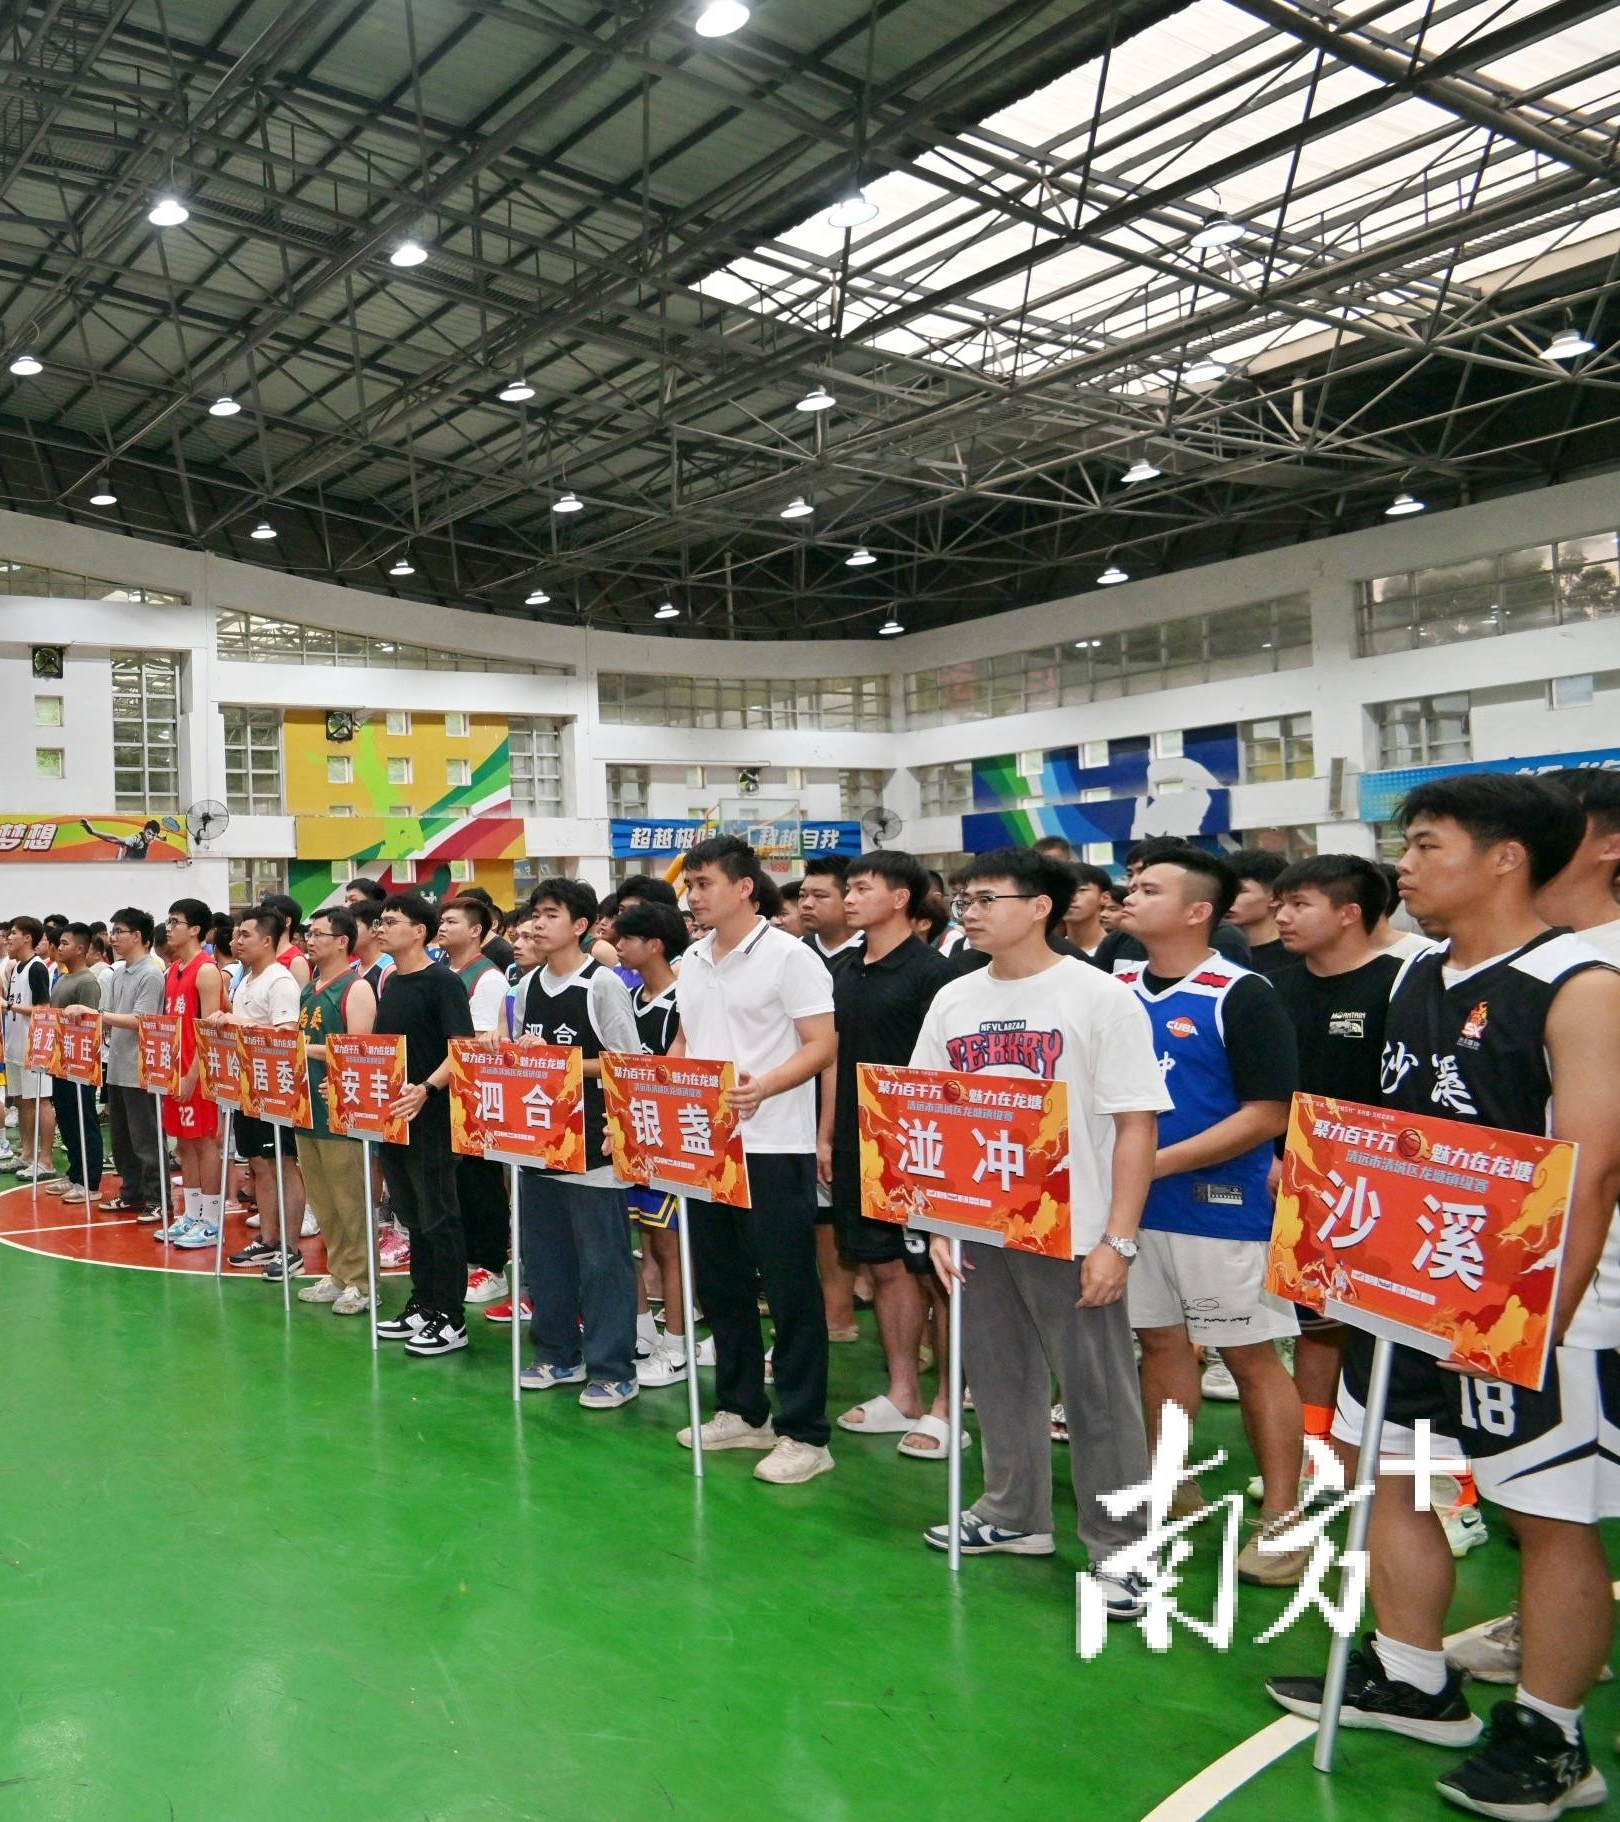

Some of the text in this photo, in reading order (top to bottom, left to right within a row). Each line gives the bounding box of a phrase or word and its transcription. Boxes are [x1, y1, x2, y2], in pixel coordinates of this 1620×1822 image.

[63, 1032, 93, 1062] 新庄
[1166, 1020, 1199, 1035] CUBA
[146, 1040, 171, 1070] 云路
[252, 1058, 295, 1095] 居委
[341, 1068, 391, 1108] 安丰
[877, 1080, 1044, 1111] 聚力百千万 魅力在龙塘
[474, 1079, 554, 1130] 泗合
[629, 1097, 715, 1157] 银盏
[1312, 1119, 1535, 1182] 聚力百千万 魅力在龙塘
[1314, 1169, 1490, 1291] 沙溪
[1459, 1374, 1515, 1437] 18
